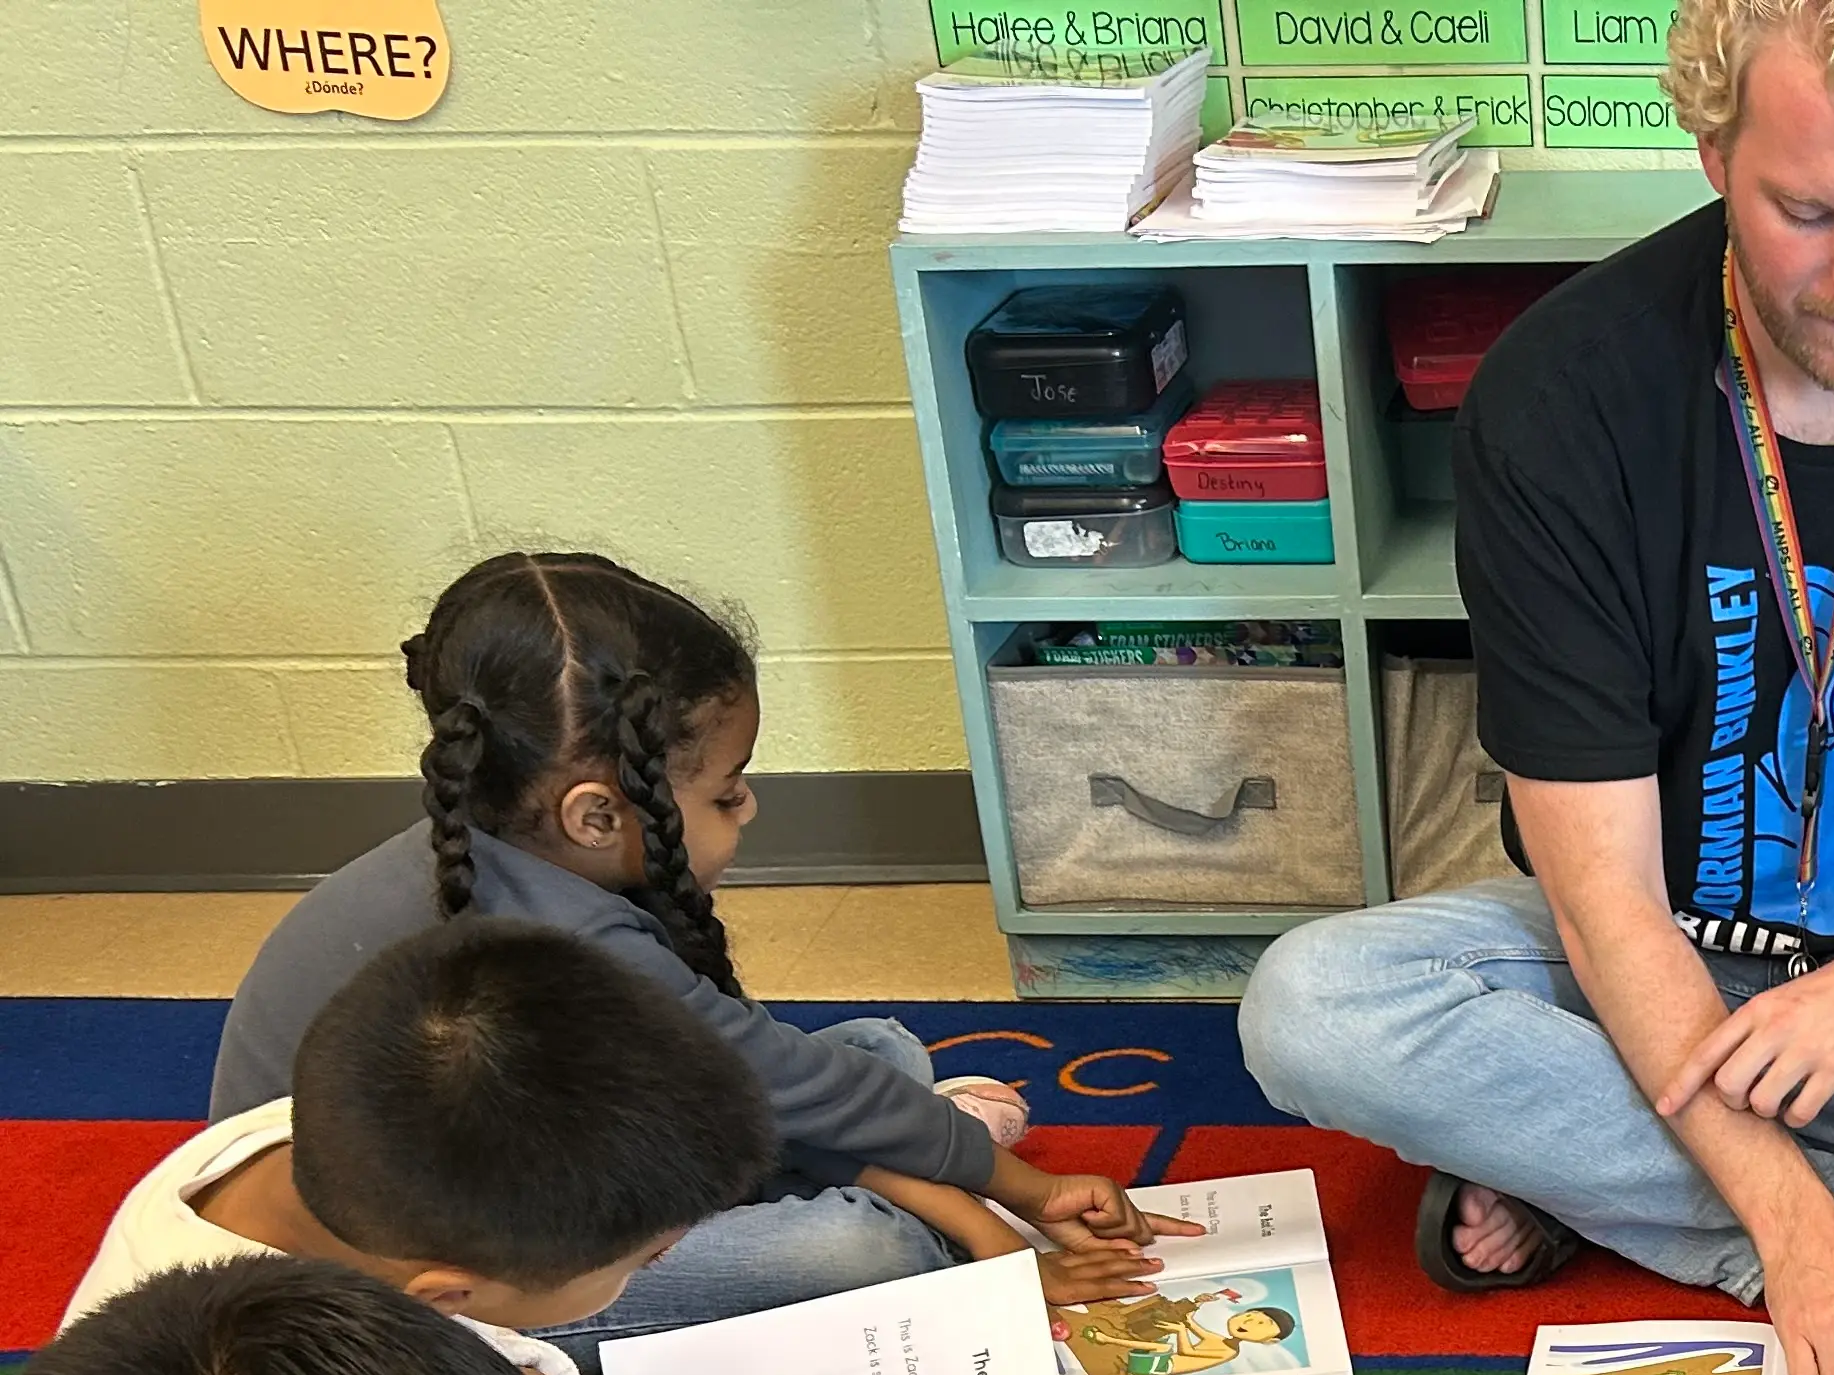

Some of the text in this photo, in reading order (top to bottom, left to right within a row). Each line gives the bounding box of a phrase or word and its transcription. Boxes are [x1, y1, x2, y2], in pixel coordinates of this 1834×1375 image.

[952, 11, 1208, 46] Hailee & Briana
[1276, 10, 1490, 45] David & Caeli
[1574, 10, 1658, 44] Liam
[217, 25, 438, 79] WHERE?
[304, 80, 364, 96] ¿Dónde?
[1456, 95, 1529, 125] Erick
[1021, 374, 1077, 403] Jose
[1731, 355, 1752, 401] MNPS
[1748, 423, 1765, 449] ALL
[1197, 471, 1265, 498] Destiny
[1215, 532, 1277, 553] Briana
[1772, 521, 1791, 566] MNPS
[1788, 588, 1802, 611] ALL
[1706, 563, 1759, 752] BINKLEY
[863, 1326, 880, 1355] Zack
[898, 1317, 911, 1342] This
[869, 1358, 881, 1368] is
[904, 1344, 914, 1354] is
